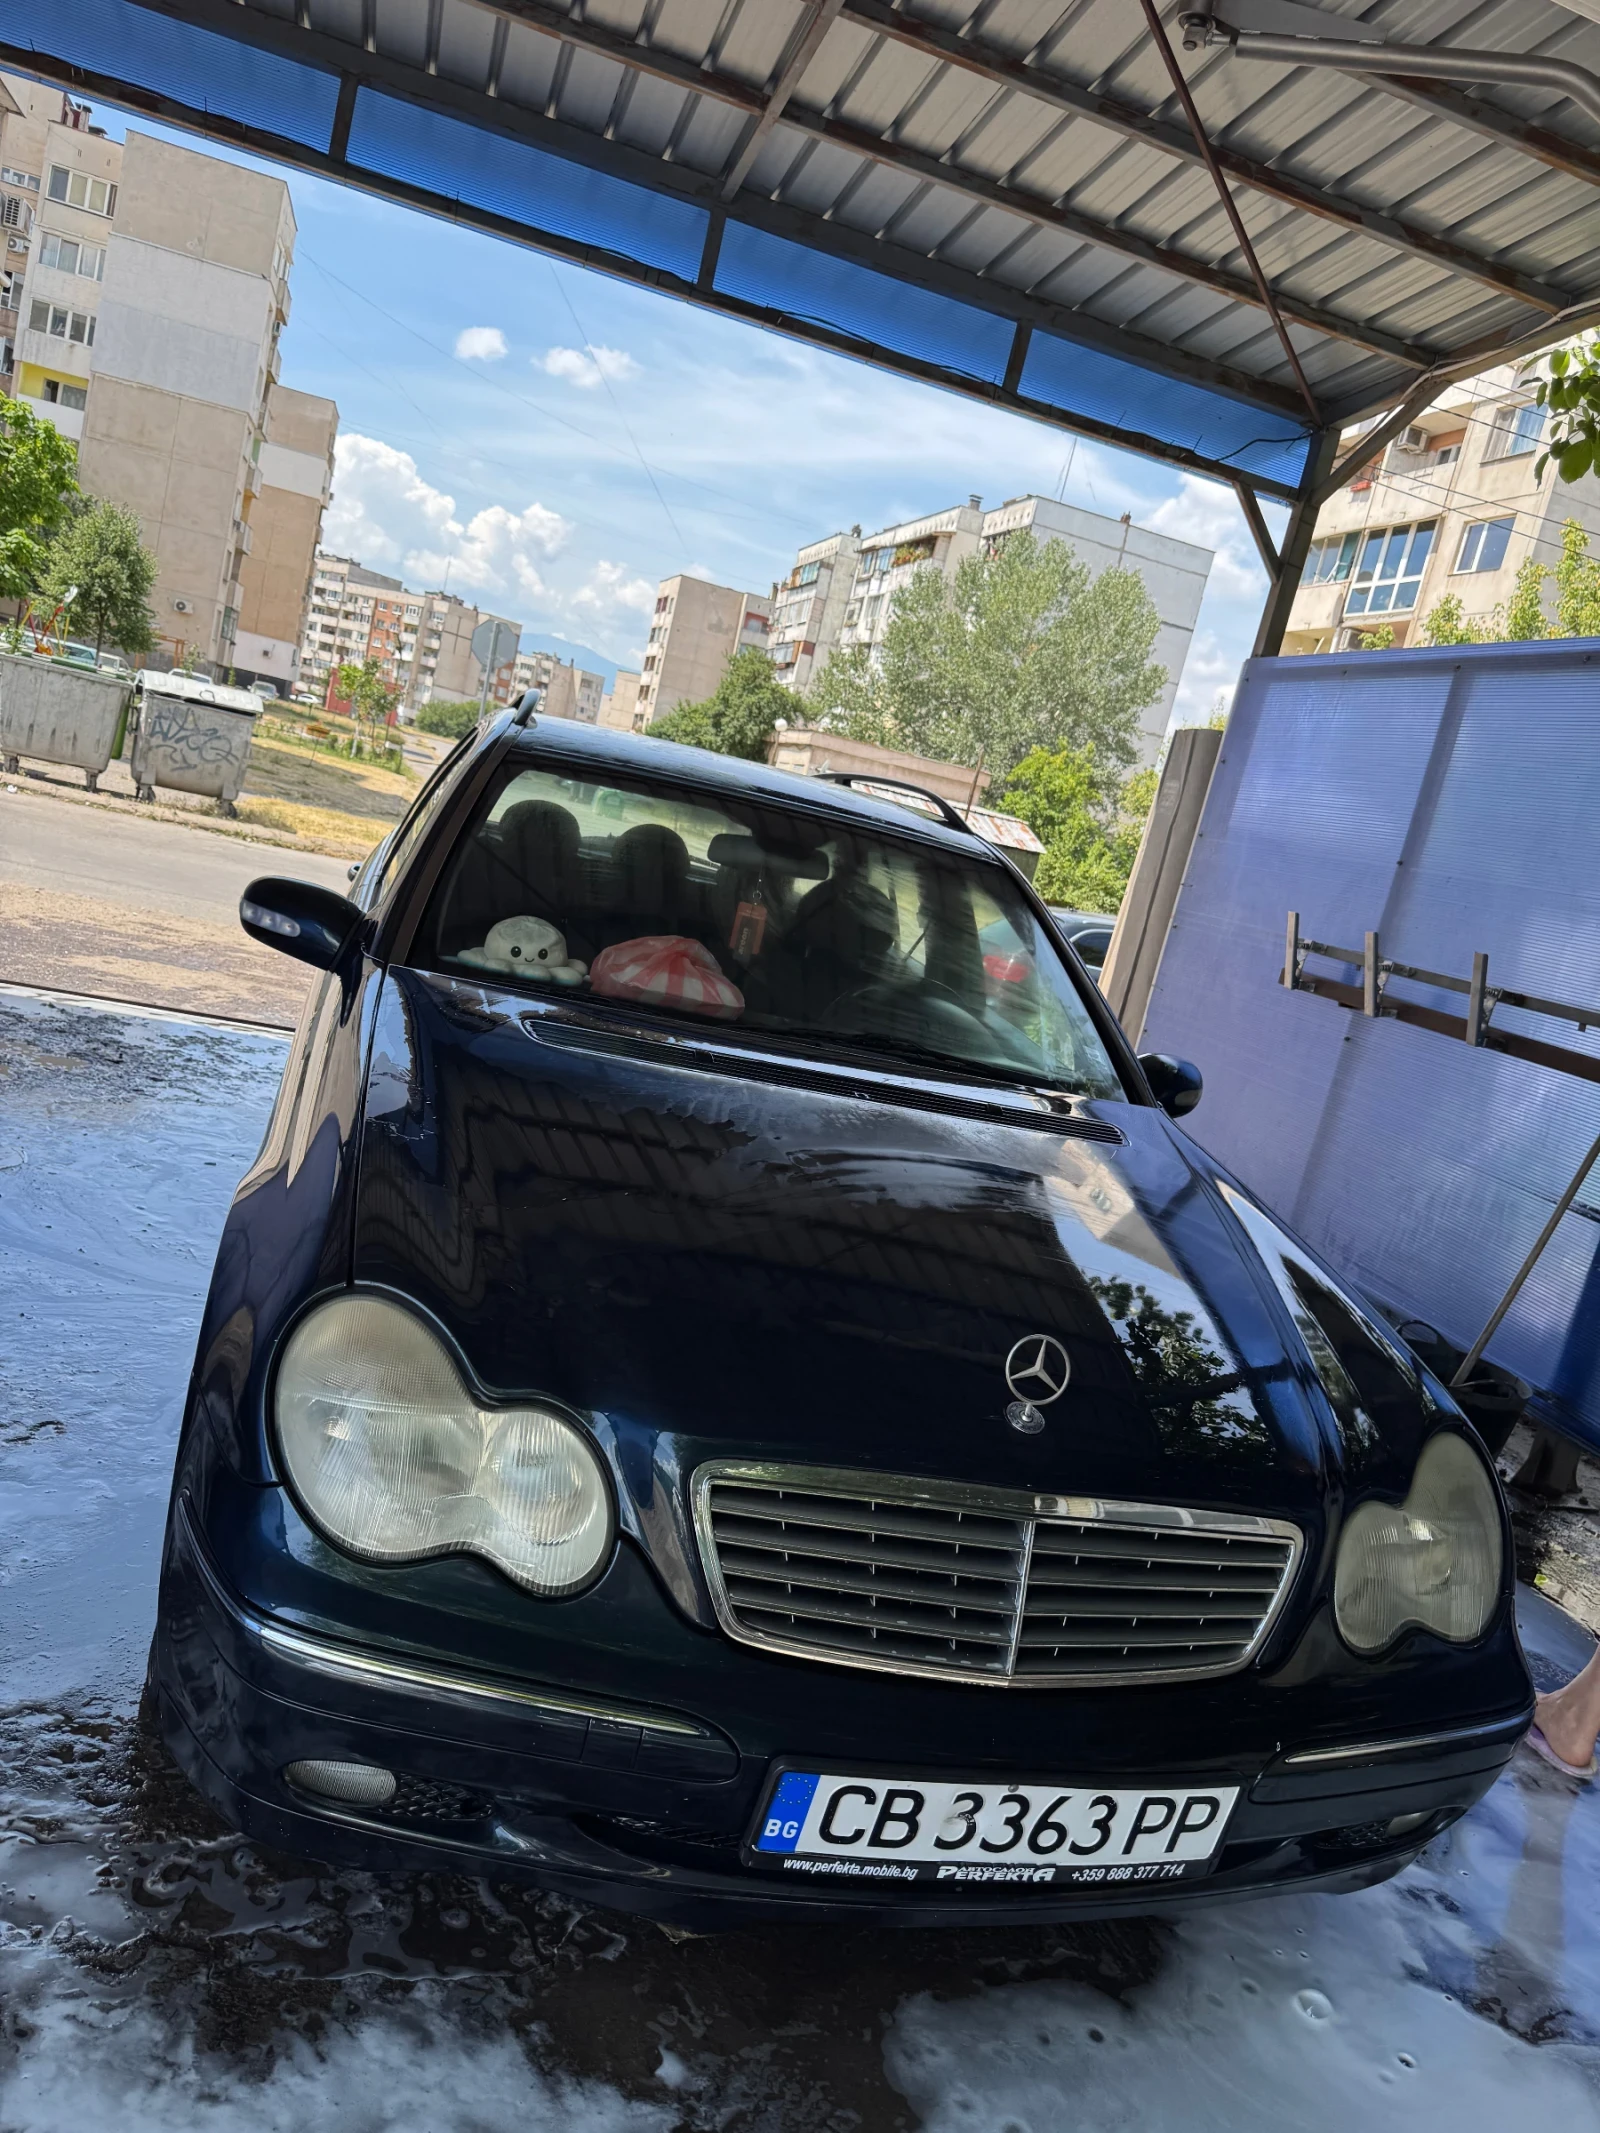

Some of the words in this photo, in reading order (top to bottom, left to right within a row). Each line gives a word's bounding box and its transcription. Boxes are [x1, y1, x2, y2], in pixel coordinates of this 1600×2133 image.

[763, 1818, 799, 1838] BG
[818, 1784, 925, 1849] CB
[932, 1792, 1118, 1856] 3363
[1121, 1796, 1221, 1855] PP
[783, 1858, 919, 1880] www.perfekta.mobile.bg
[1071, 1868, 1106, 1881] +359
[1106, 1867, 1133, 1880] 888
[1133, 1865, 1160, 1878] 377
[1160, 1864, 1186, 1877] 714
